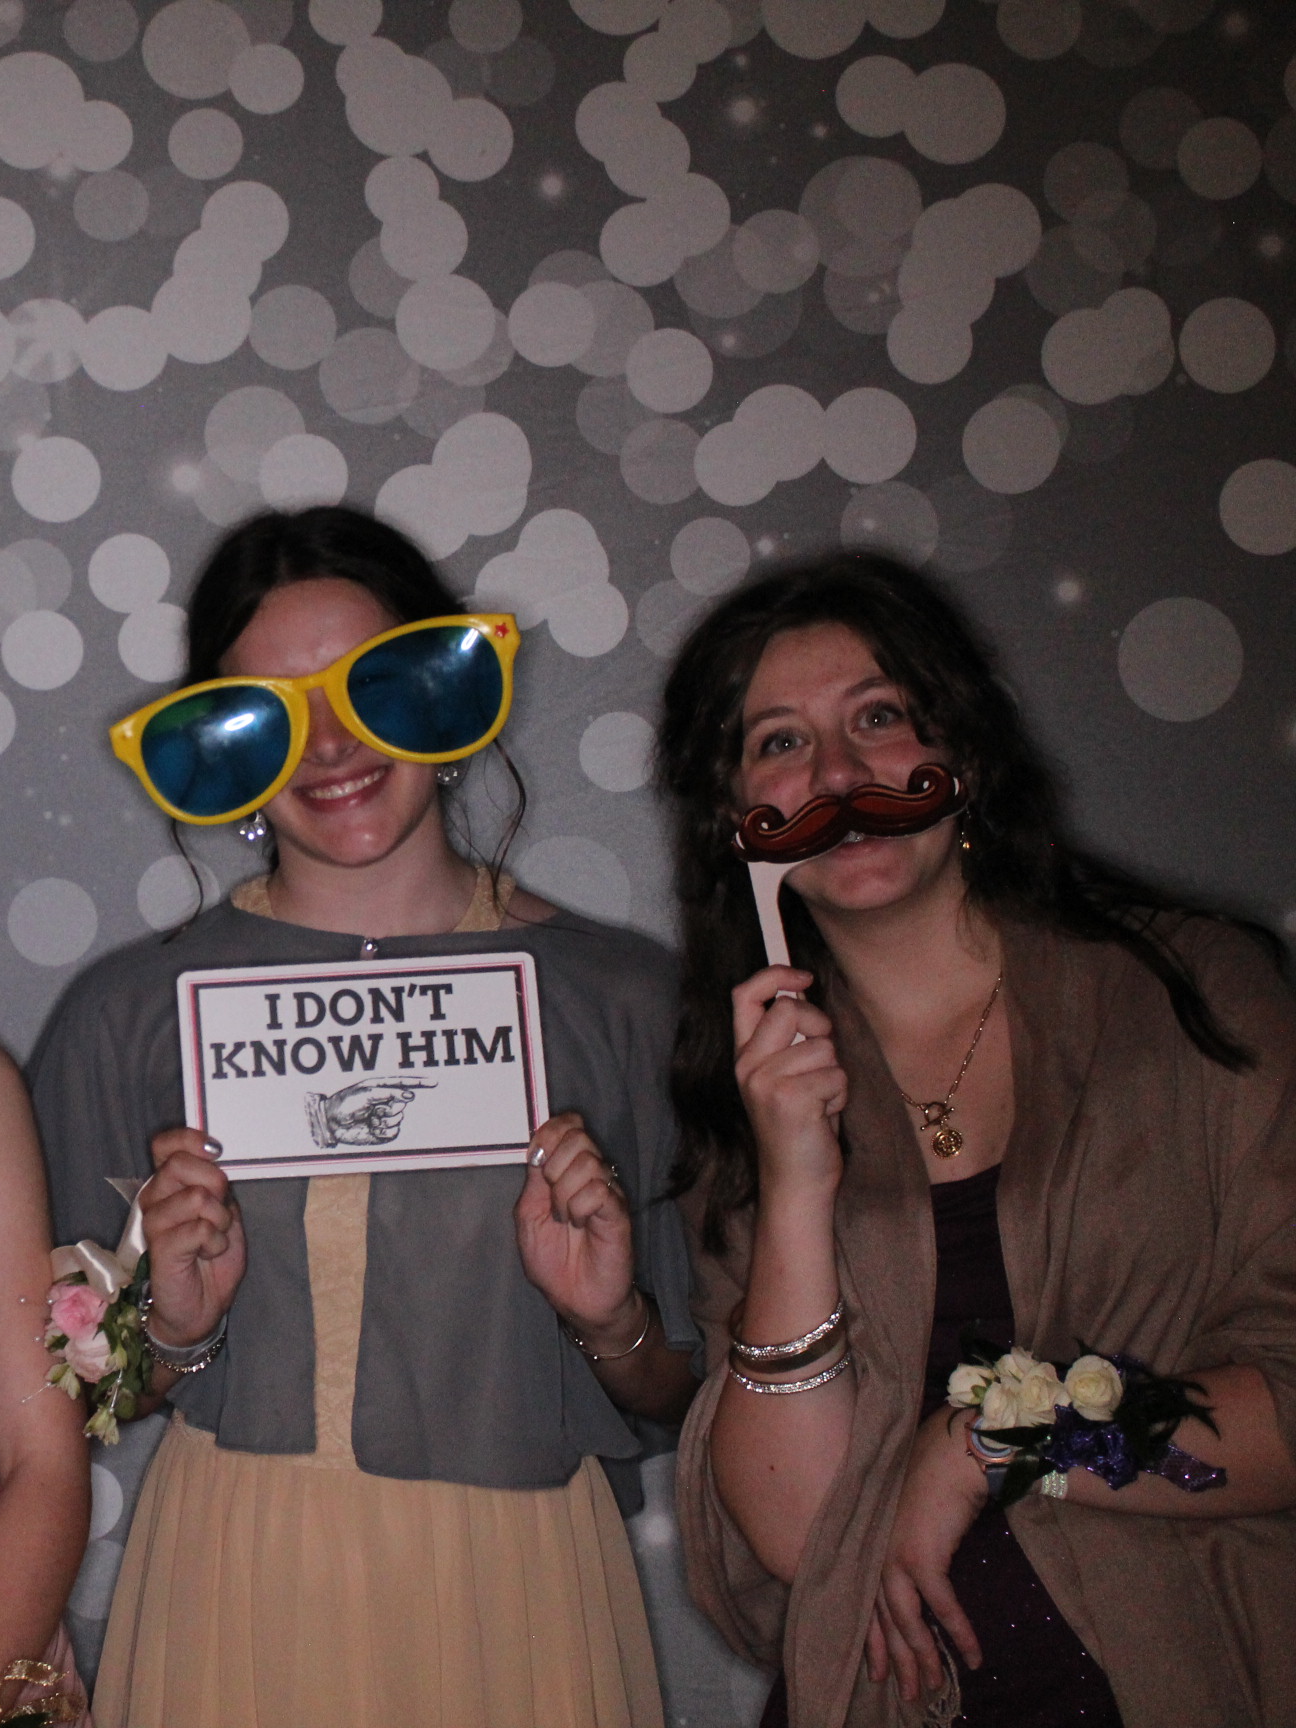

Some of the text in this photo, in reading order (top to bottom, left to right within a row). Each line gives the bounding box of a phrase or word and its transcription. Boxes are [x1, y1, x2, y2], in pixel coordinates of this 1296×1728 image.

[264, 983, 453, 1030] I DON'T
[209, 1026, 515, 1080] KNOW HIM
